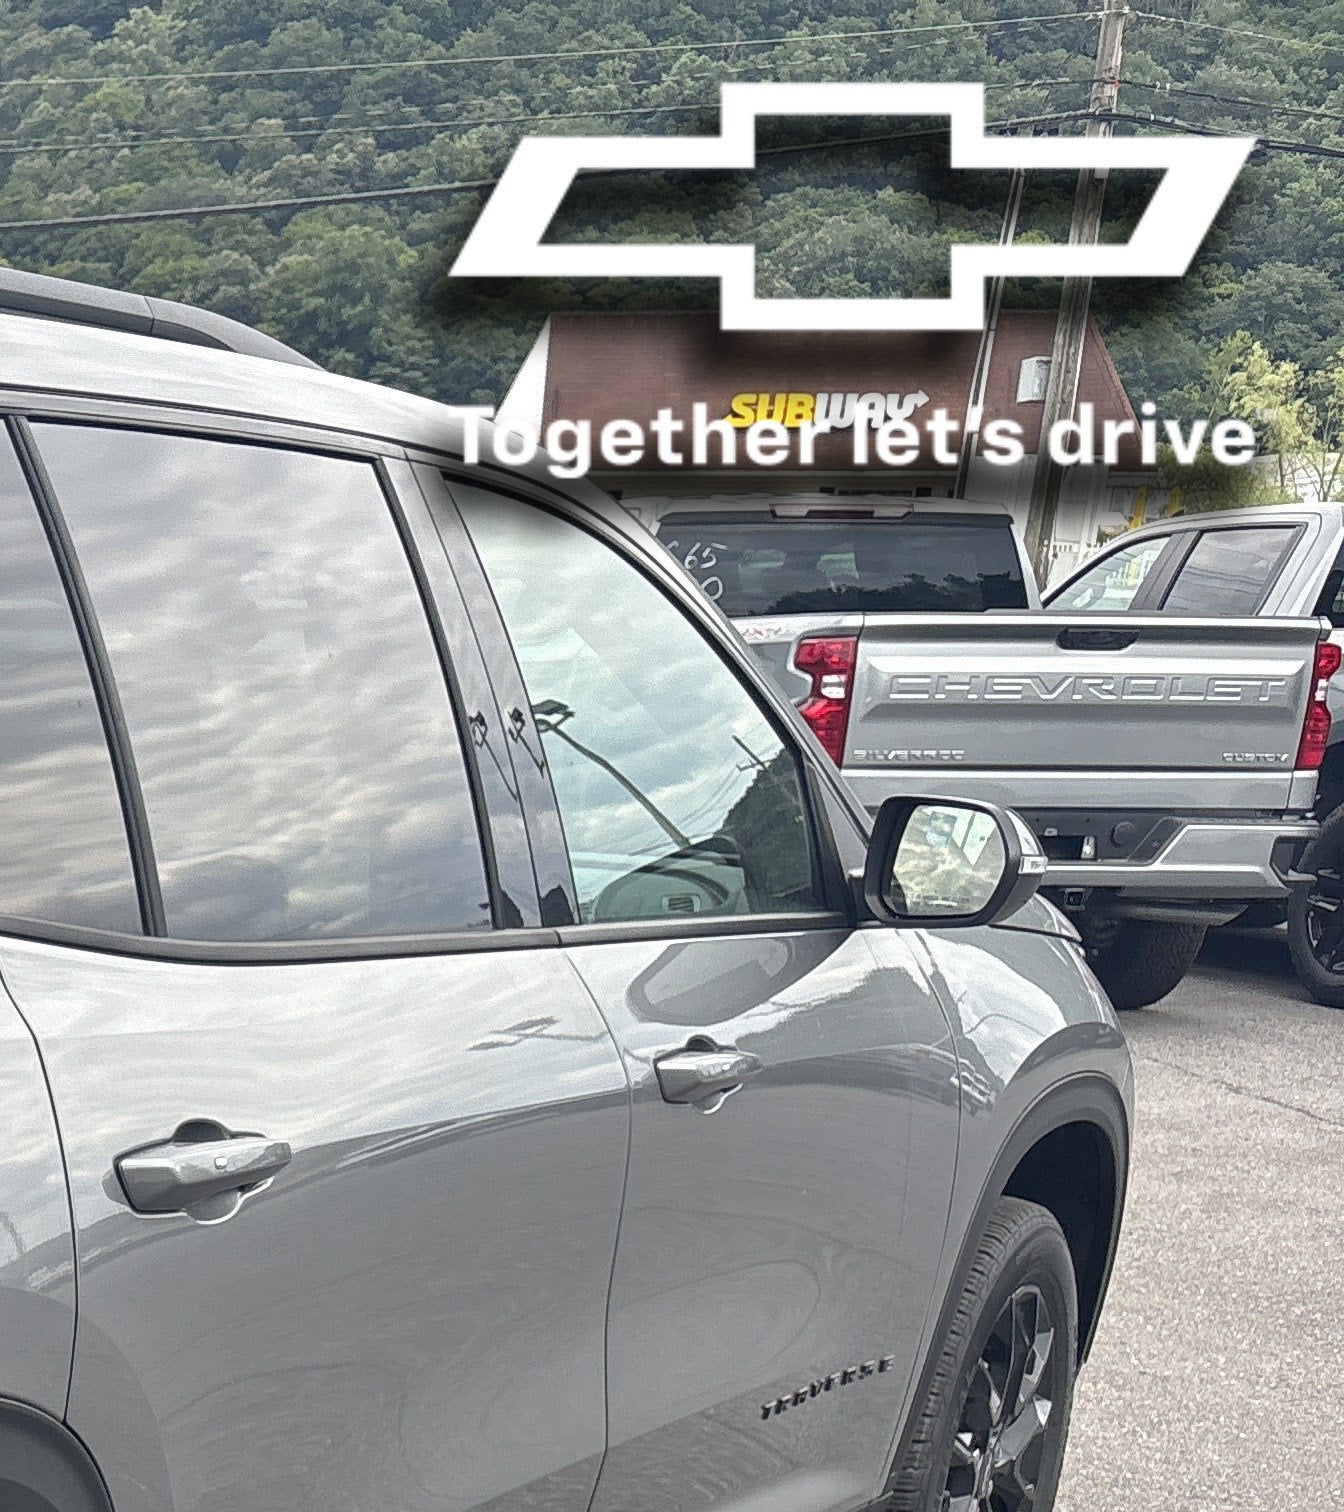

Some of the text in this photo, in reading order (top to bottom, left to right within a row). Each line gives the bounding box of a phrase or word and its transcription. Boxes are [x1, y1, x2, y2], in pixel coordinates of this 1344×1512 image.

[723, 391, 929, 429] SUBWAY
[888, 675, 1286, 702] CHEVROLET
[761, 1355, 896, 1420] TRAVERSE
